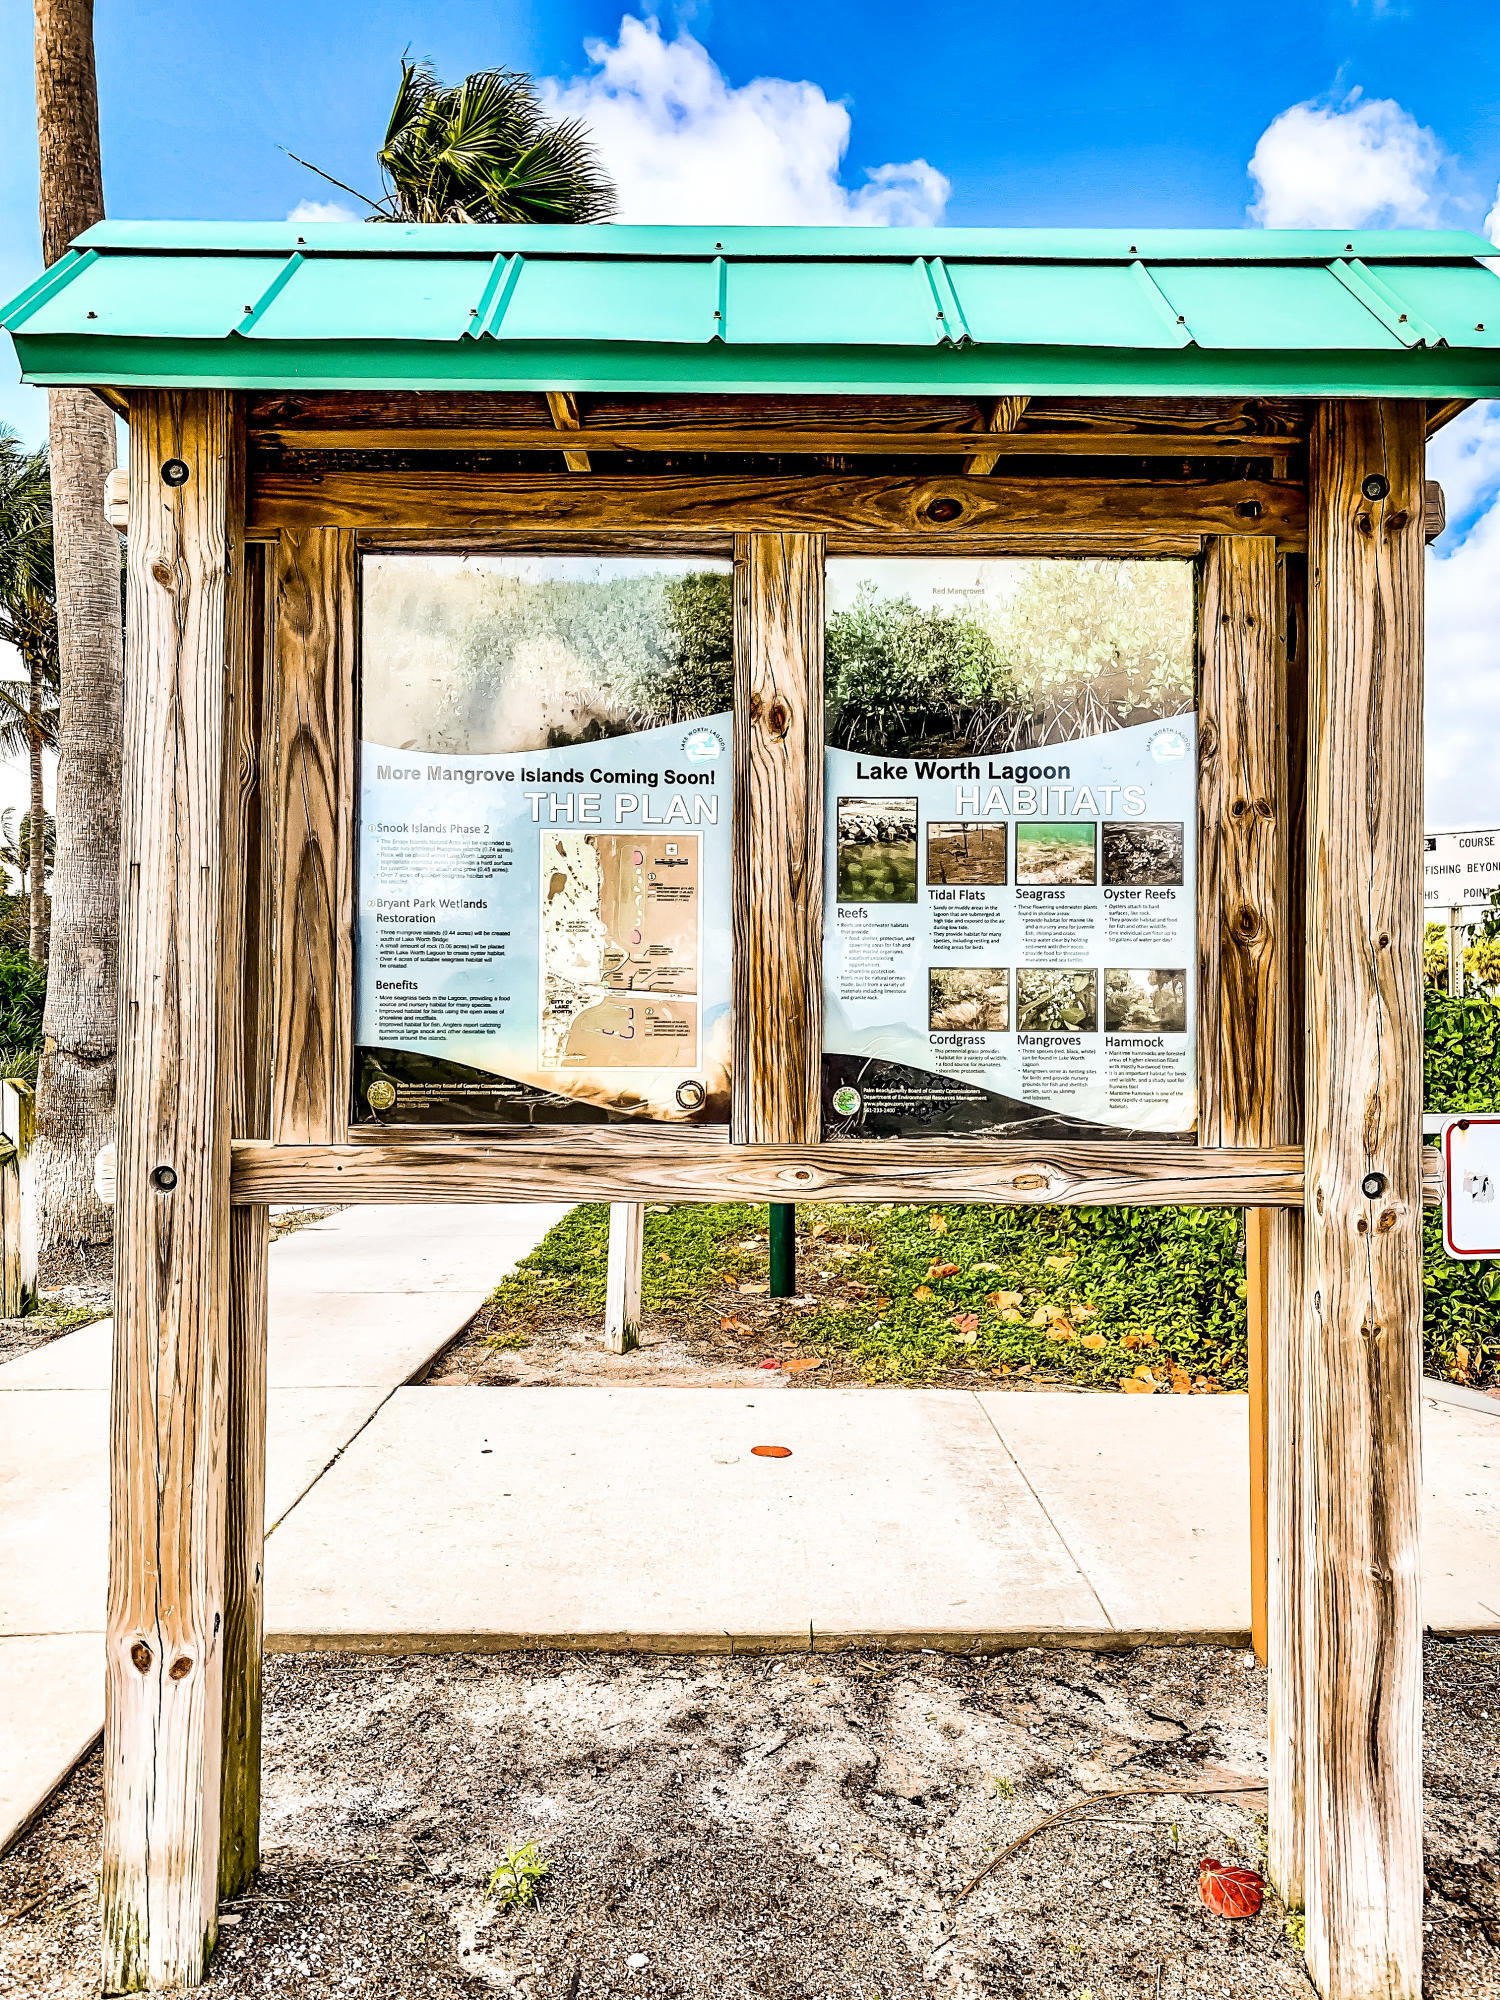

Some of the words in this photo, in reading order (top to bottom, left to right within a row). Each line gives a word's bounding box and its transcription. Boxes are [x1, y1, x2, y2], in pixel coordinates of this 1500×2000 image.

[680, 737, 688, 750] LAKE
[688, 728, 708, 736] WORTH
[710, 730, 725, 751] LAGOON
[377, 766, 421, 781] More
[427, 767, 514, 785] Mangrove
[521, 768, 584, 783] Islands
[590, 769, 658, 788] Coming
[664, 770, 715, 784] Soon!
[856, 762, 908, 780] Lake
[915, 763, 980, 780] Worth
[989, 763, 1070, 782] Lagoon
[955, 785, 1147, 816] HABITATS
[523, 792, 601, 822] THE
[615, 794, 718, 824] PLAN
[377, 824, 408, 833] Snook
[412, 824, 446, 834] Islands
[450, 824, 480, 834] Phase
[484, 825, 489, 834] 2
[1459, 837, 1495, 848] COURSE
[1425, 864, 1460, 875] FISHING
[1468, 862, 1500, 872] BEYON
[928, 890, 955, 900] Tidal
[959, 890, 985, 900] Flats
[1016, 889, 1065, 901] Seagrass
[1104, 889, 1141, 901] Oyster
[1146, 889, 1176, 899] Reefs
[1424, 890, 1438, 900] HIS
[377, 899, 410, 909] Bryant
[414, 899, 435, 908] Park
[439, 899, 488, 908] Wetlands
[376, 914, 435, 923] Restoration
[838, 908, 868, 918] Reefs
[376, 980, 418, 990] Benefits
[930, 1034, 985, 1046] Cordgrass
[1018, 1035, 1081, 1047] Mangroves
[1106, 1037, 1164, 1047] Hammock
